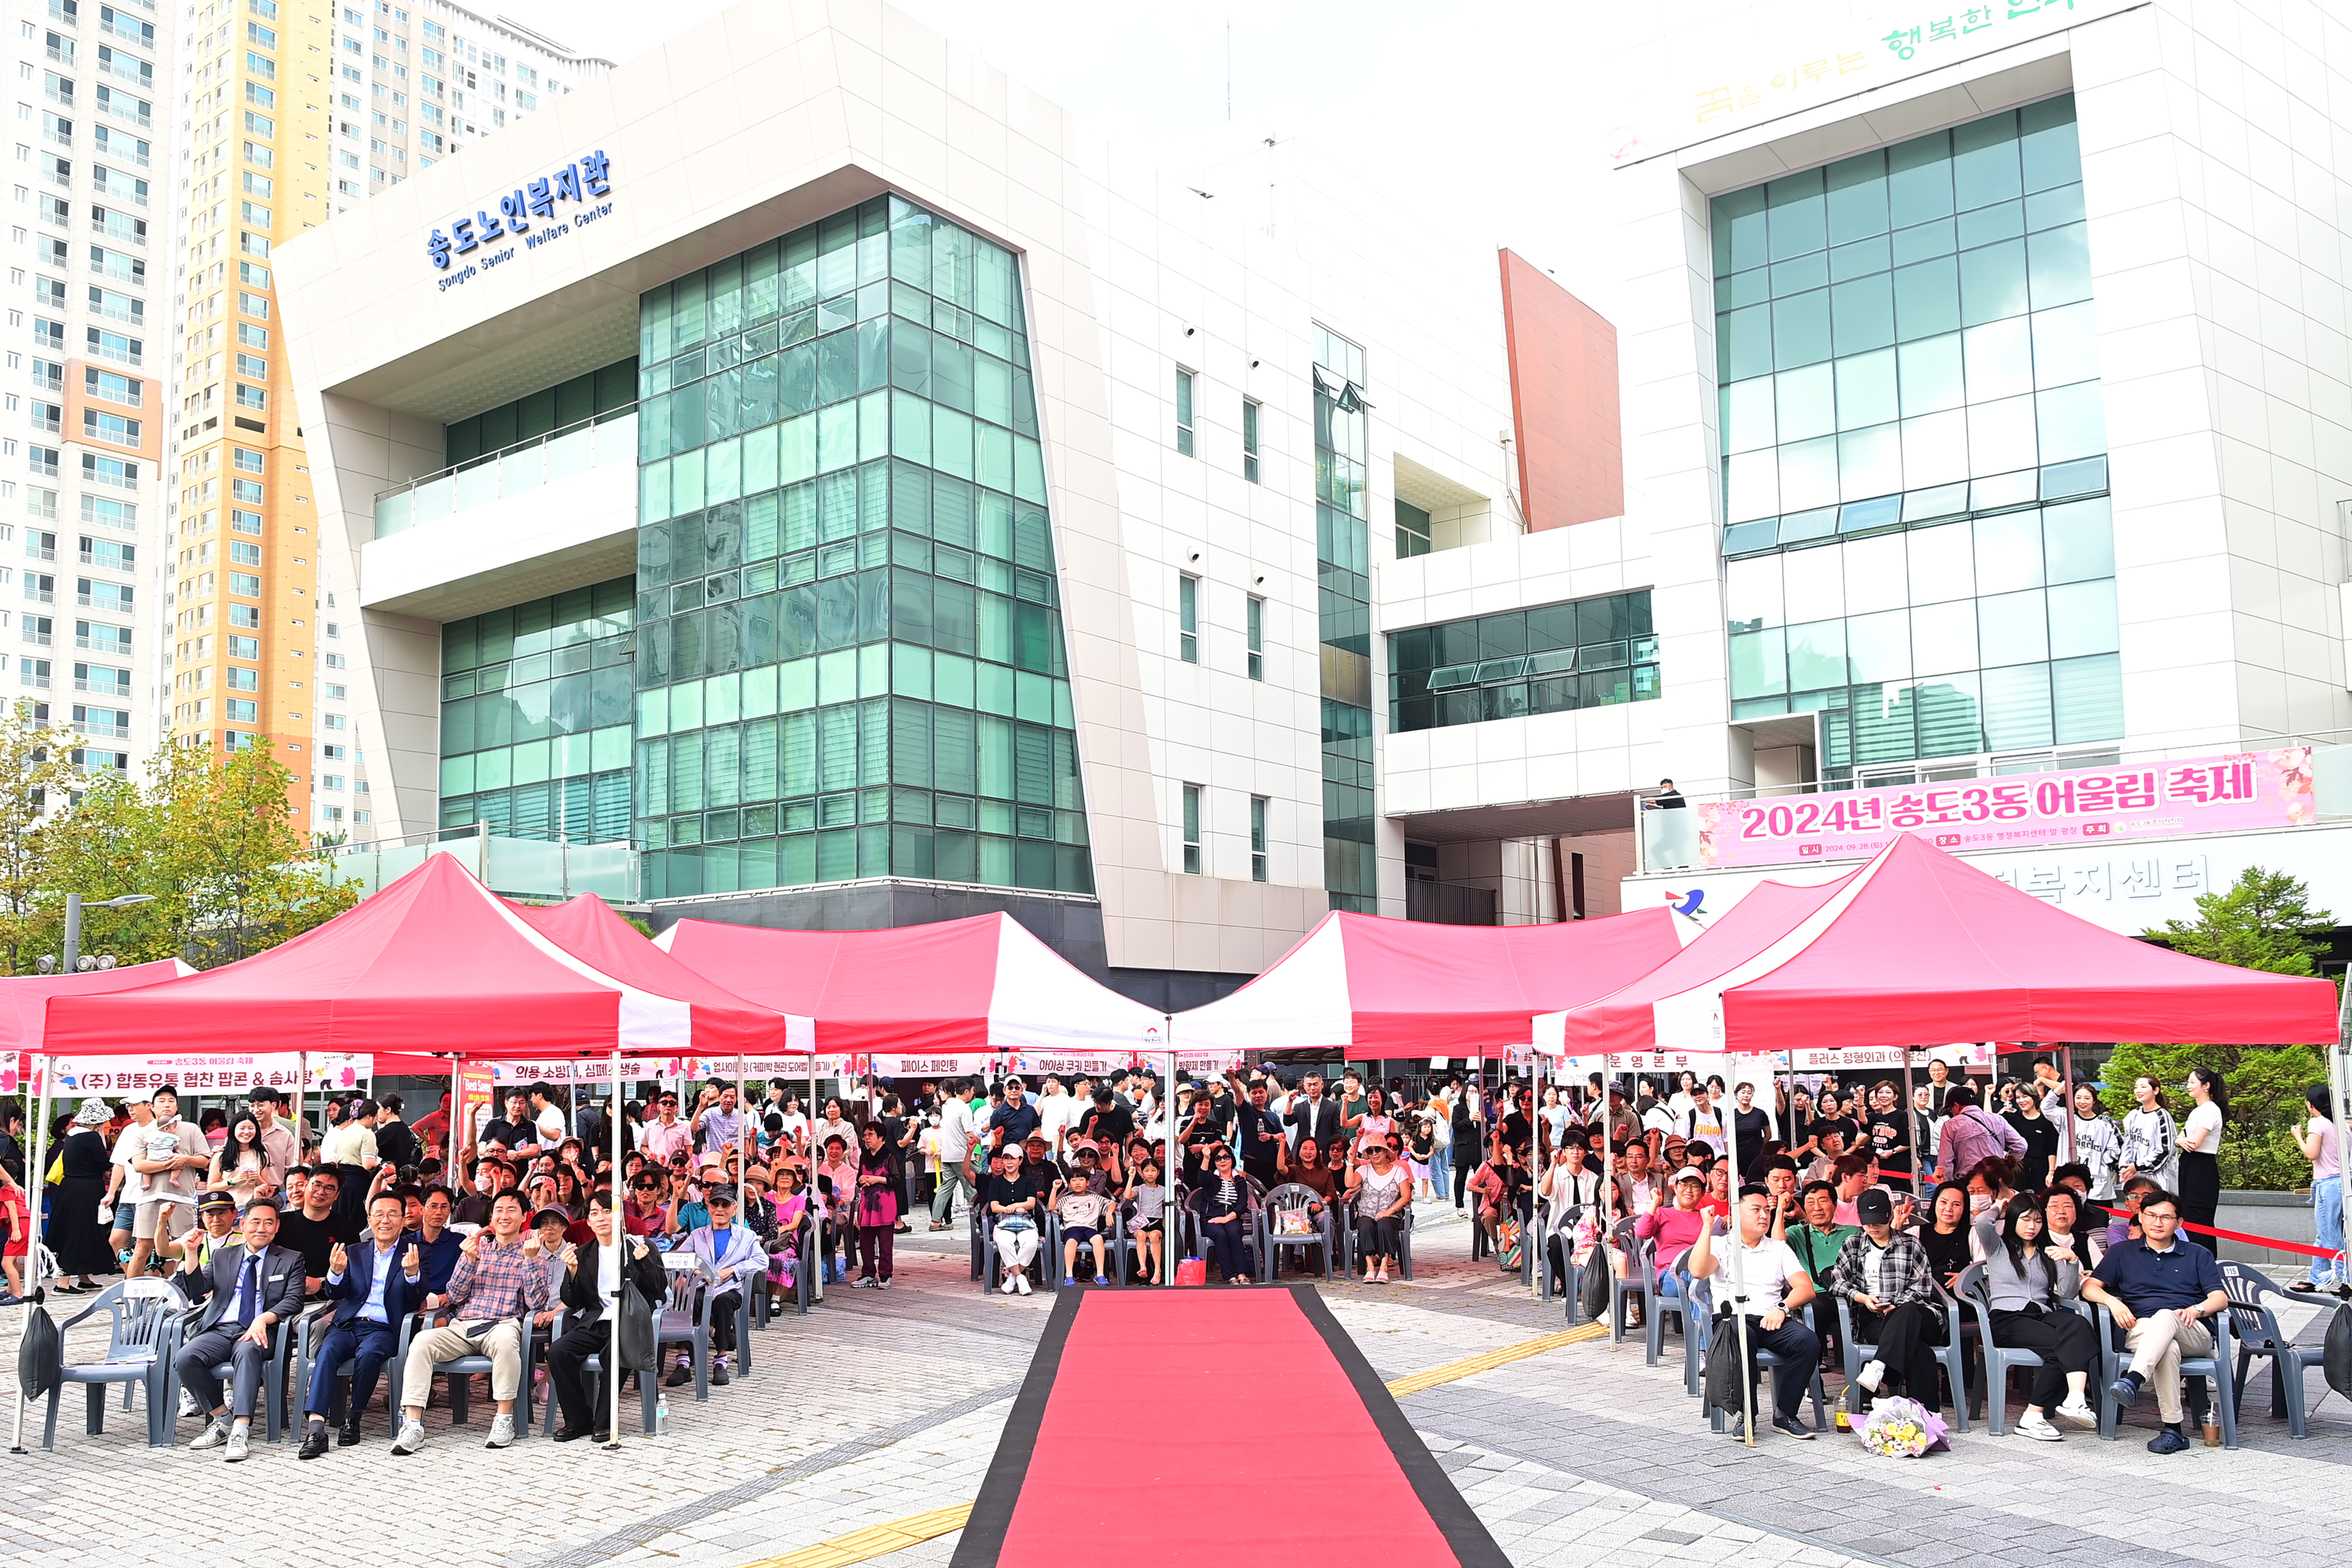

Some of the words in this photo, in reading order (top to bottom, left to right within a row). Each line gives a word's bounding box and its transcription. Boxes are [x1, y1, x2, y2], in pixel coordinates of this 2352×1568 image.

[1696, 86, 1762, 123] 꿈을
[1770, 51, 1867, 91] 이루는
[1881, 5, 1992, 60] 행복한
[427, 149, 611, 269] 송도노인복지관
[438, 265, 476, 292] Songdo
[480, 247, 515, 270] Senior
[525, 222, 569, 249] Welfare
[574, 201, 613, 227] Center
[1742, 798, 1881, 838] 2024년
[1890, 785, 2028, 827] 송도3동
[2036, 773, 2155, 815] 어울림
[2168, 763, 2253, 803] 축제
[1964, 833, 1993, 843] 송도3동
[1997, 829, 2046, 840] 행정복지센터
[2049, 828, 2057, 836] 앞
[2061, 826, 2077, 835] 광장
[1995, 854, 2209, 904] 복지센터
[1039, 1059, 1065, 1071] 아이싱
[1066, 1060, 1082, 1071] 쿠키
[1084, 1060, 1107, 1072] 만들기
[1179, 1060, 1198, 1071] 방향제
[1200, 1059, 1219, 1071] 만들기
[1808, 1052, 1840, 1065] 플러스
[1842, 1052, 1886, 1064] 정형외과
[515, 1065, 540, 1078] 의용
[814, 1061, 830, 1071] 들기)
[901, 1060, 929, 1073] 페이스
[930, 1059, 958, 1072] 페인팅
[82, 1074, 111, 1089] (주)
[117, 1073, 179, 1089] 합동유통
[184, 1071, 214, 1087] 협찬
[218, 1071, 248, 1087] 팝콘
[252, 1072, 264, 1086] &
[2076, 1140, 2103, 1152] ngeles
[2130, 1133, 2151, 1147] ngeles
